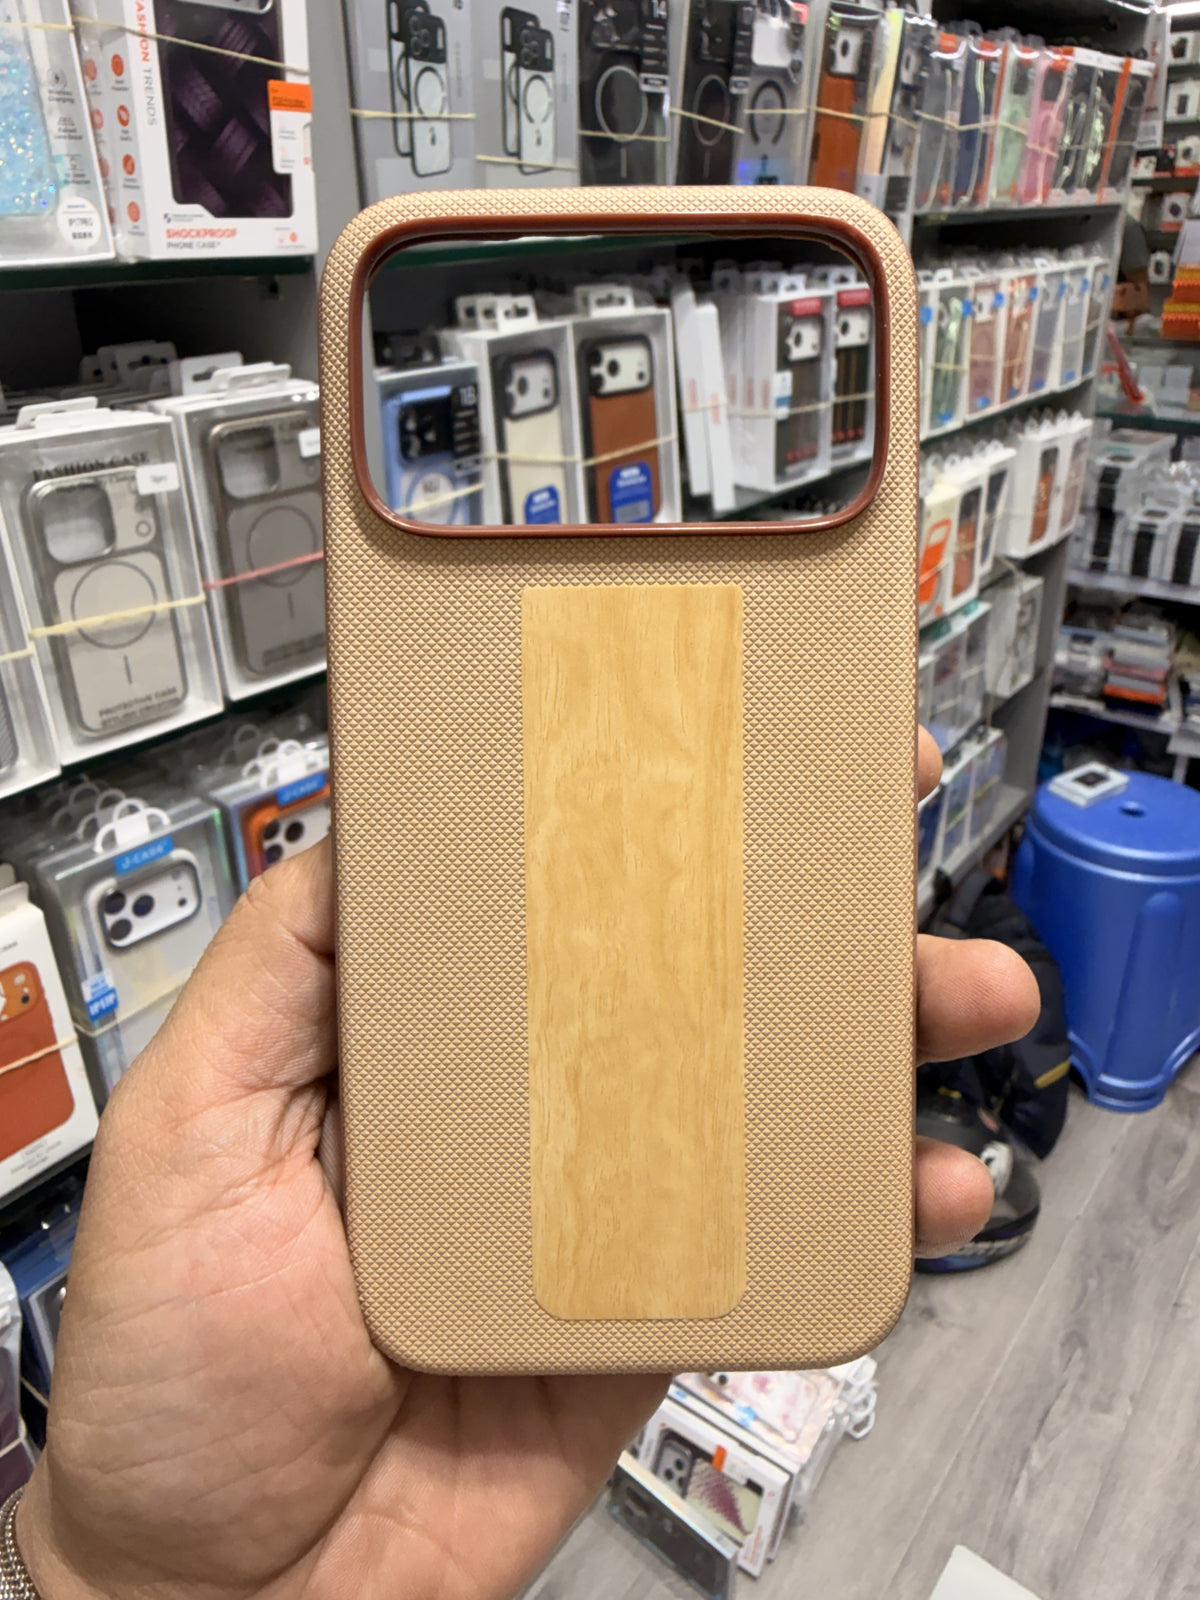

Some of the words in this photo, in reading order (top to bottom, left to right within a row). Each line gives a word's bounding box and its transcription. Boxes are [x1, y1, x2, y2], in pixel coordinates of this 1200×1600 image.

[143, 68, 157, 126] TRENDS
[165, 228, 237, 239] SHOCKPROOF
[167, 241, 195, 250] PHONE
[32, 458, 106, 481] FASHION
[107, 450, 150, 467] CASE
